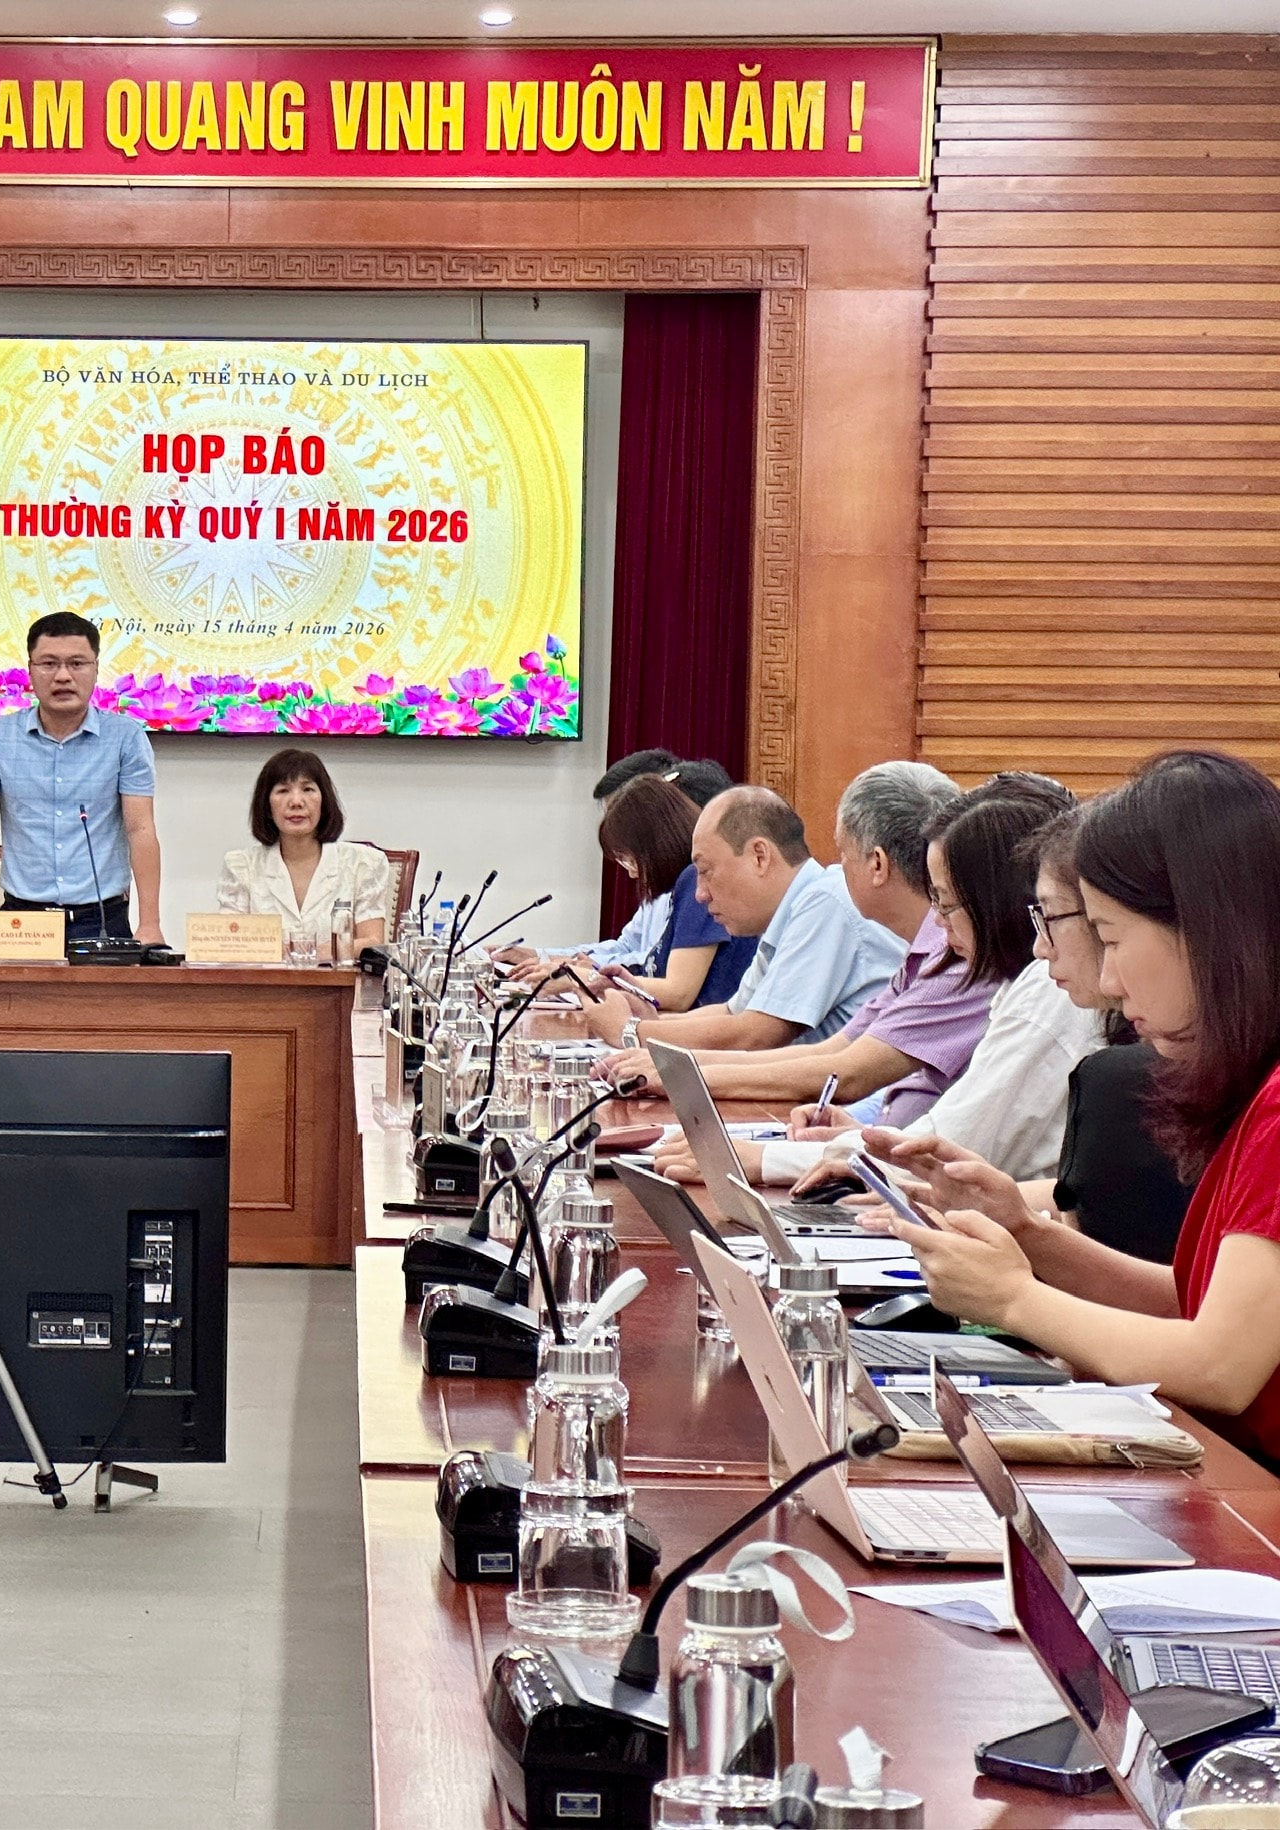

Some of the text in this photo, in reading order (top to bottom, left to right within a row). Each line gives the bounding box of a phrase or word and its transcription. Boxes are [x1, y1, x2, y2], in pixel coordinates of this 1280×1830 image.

[107, 79, 306, 157] QUANG
[331, 80, 466, 151] VINH
[487, 63, 662, 153] MUÔN
[684, 64, 825, 152] NĂM
[43, 363, 428, 391] BỘ VĂN HÓA, THỂ THAO VÀ DU LỊCH
[143, 427, 325, 482] HỌP BÁO
[0, 496, 468, 543] THƯỜNG KỲ QUÝ I NĂM 2026
[111, 617, 147, 633] Nội,
[154, 618, 195, 637] ngày
[203, 619, 222, 633] 15
[228, 618, 277, 637] tháng
[284, 620, 294, 635] 4
[300, 620, 337, 635] năm
[344, 621, 385, 636] 2026
